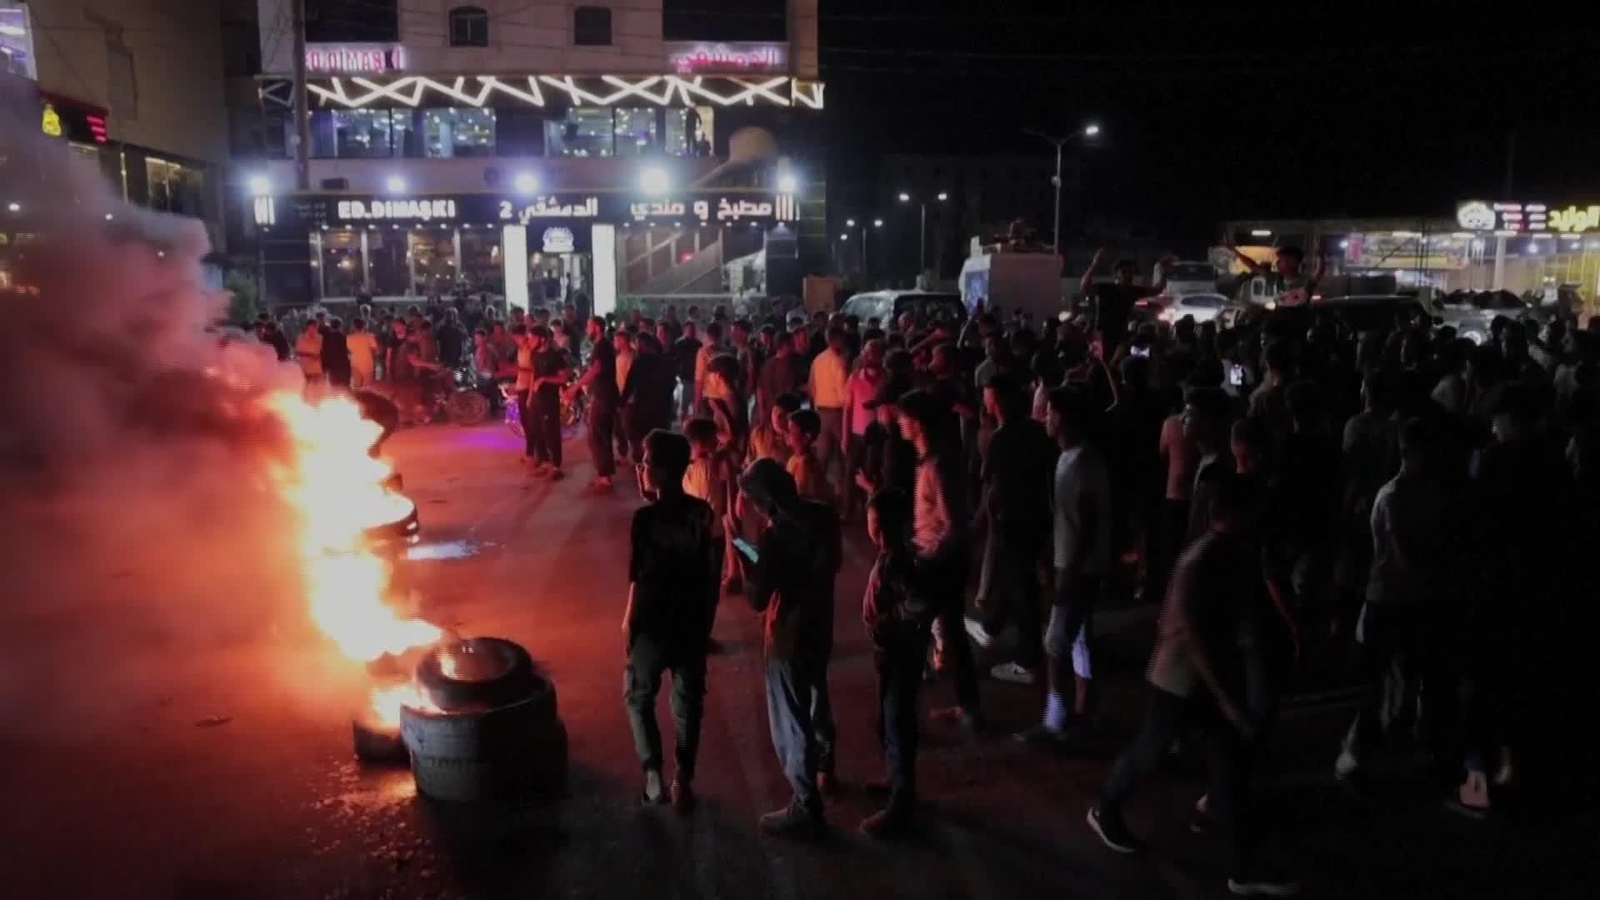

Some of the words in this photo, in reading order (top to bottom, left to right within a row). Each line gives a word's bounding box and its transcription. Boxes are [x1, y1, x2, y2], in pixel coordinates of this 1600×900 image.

[499, 200, 513, 219] 2
[518, 195, 598, 225] الدمشقي
[630, 200, 686, 220] مندي
[693, 200, 709, 220] و
[717, 198, 772, 220] مطبخ
